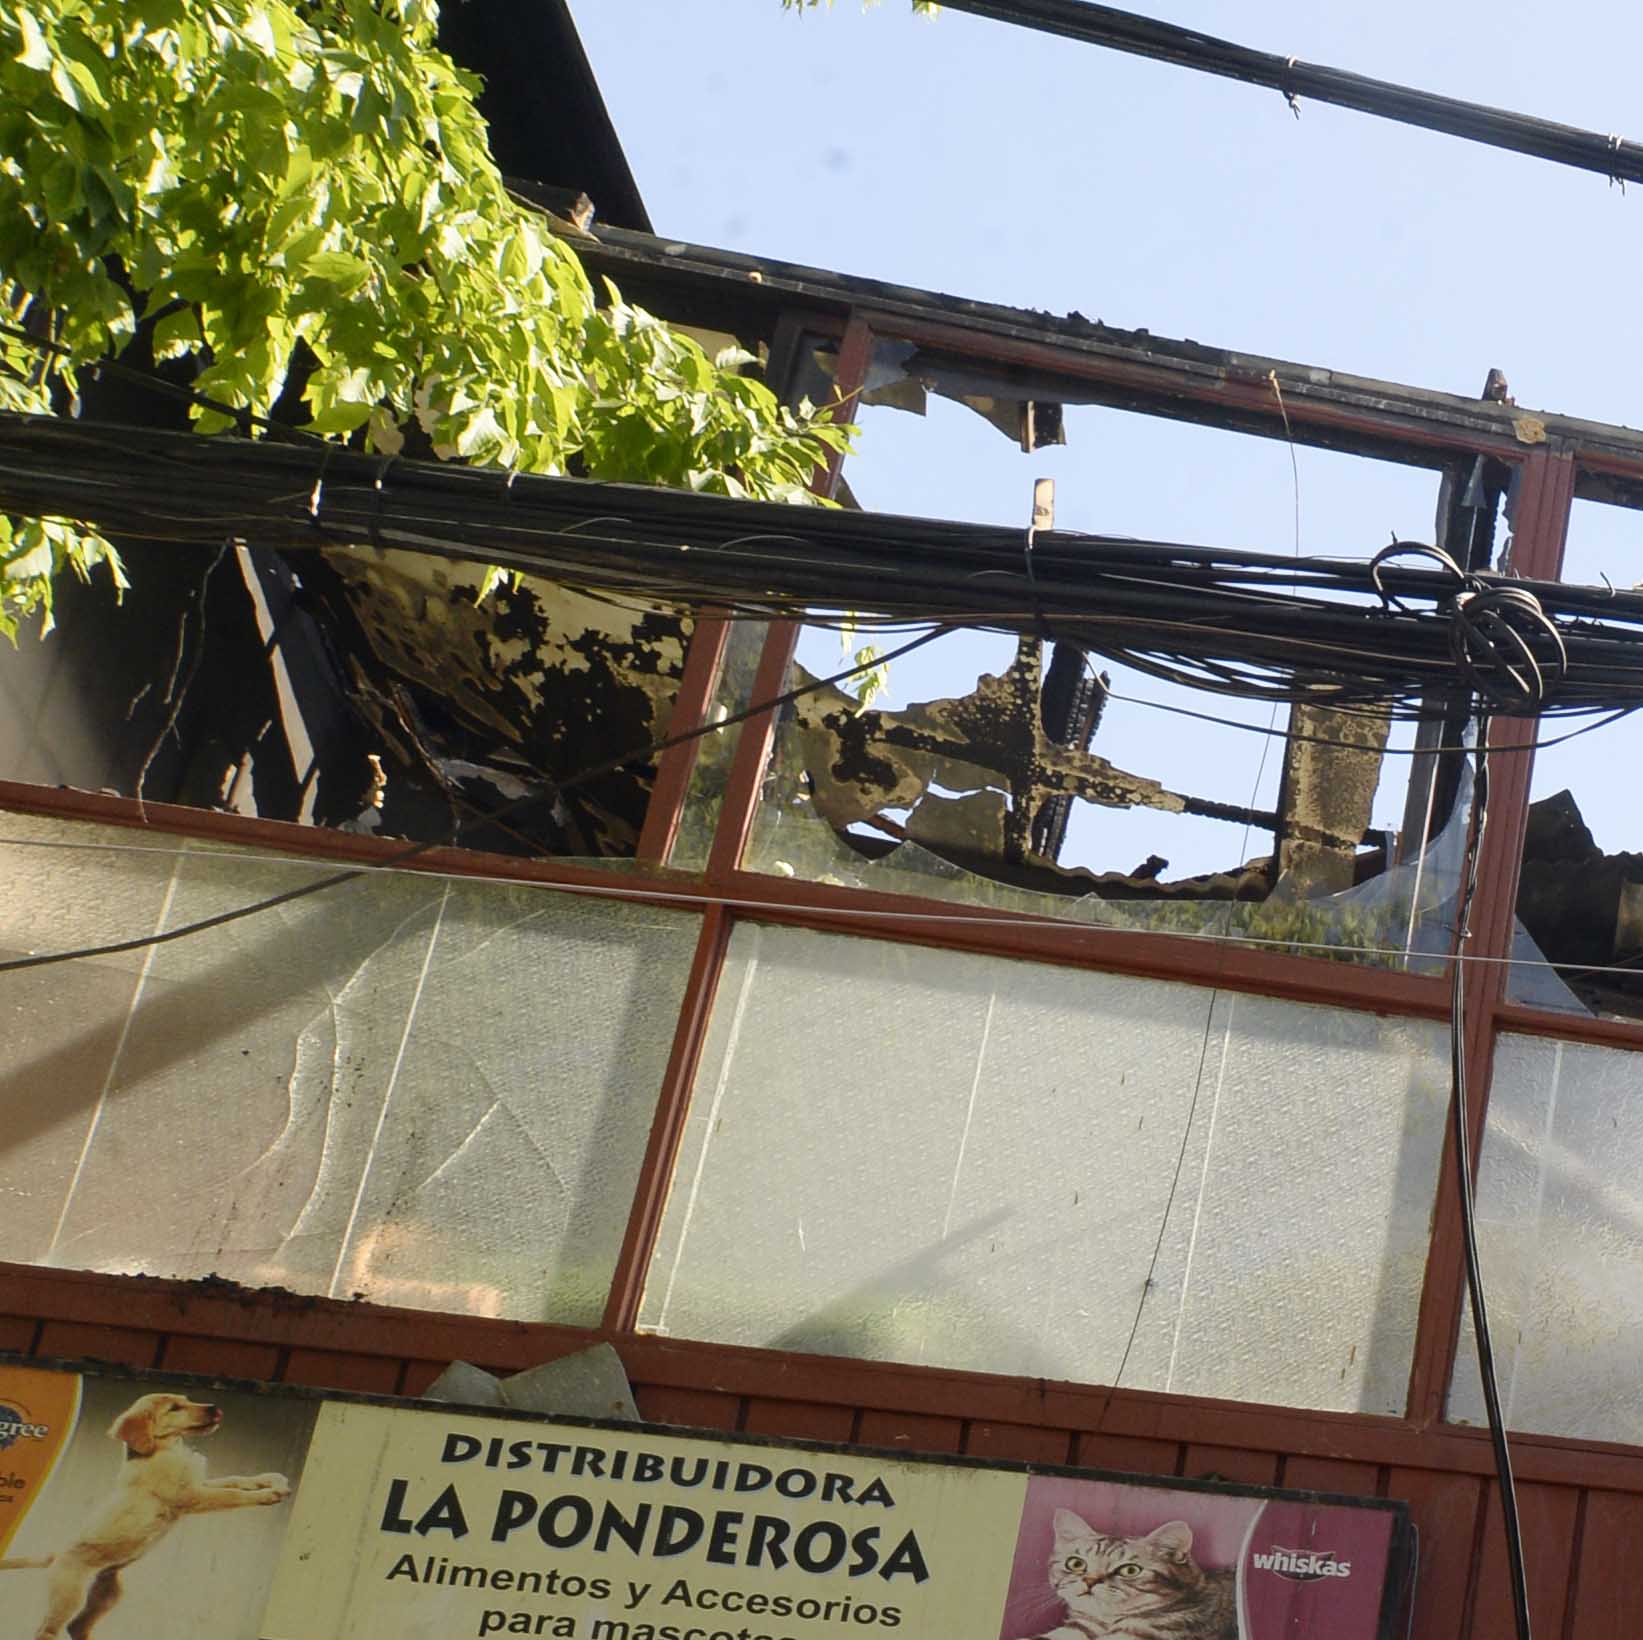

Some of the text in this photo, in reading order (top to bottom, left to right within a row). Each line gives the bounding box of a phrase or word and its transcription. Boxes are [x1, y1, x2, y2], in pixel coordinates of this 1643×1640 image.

[441, 1432, 896, 1507] DISTRIBUIDORA
[380, 1479, 930, 1584] LA PONDEROSA
[1252, 1549, 1352, 1579] whiskas
[386, 1554, 902, 1628] Alimentos y Accesorios
[478, 1609, 576, 1640] para
